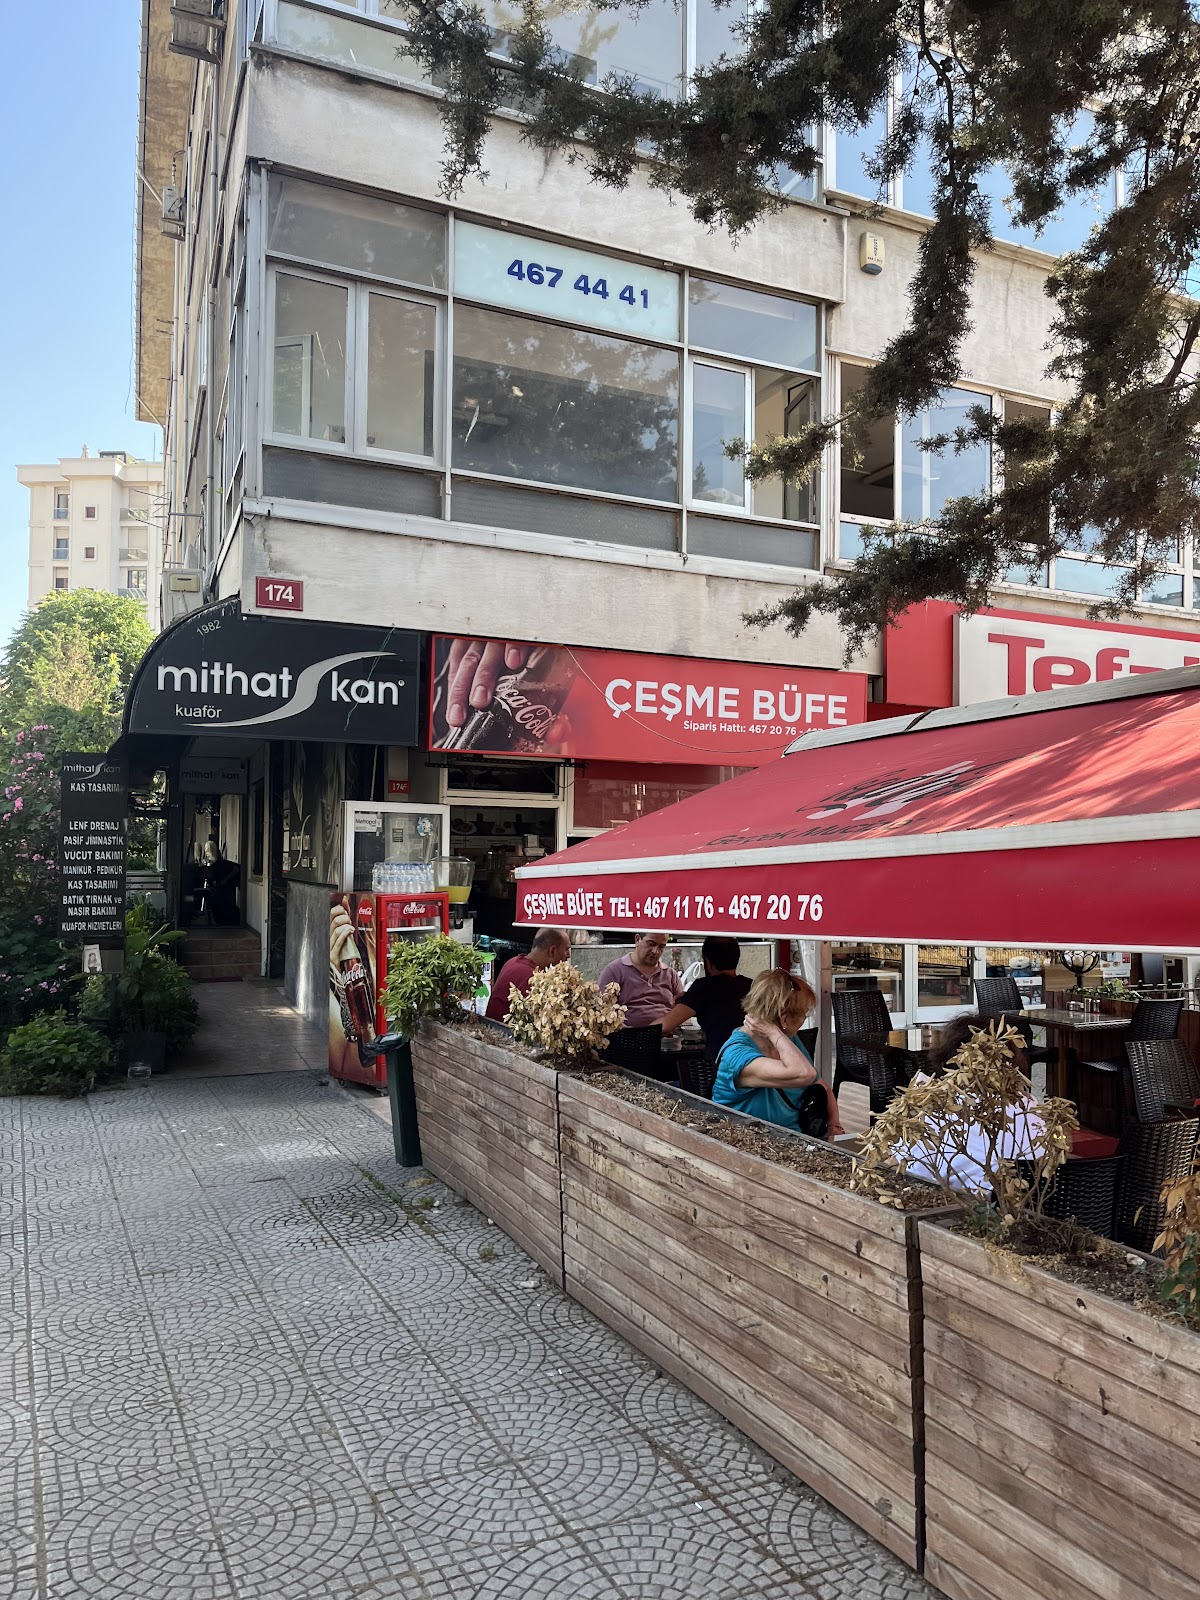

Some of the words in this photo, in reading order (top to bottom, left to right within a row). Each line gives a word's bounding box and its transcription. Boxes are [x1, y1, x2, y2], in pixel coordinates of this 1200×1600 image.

[507, 259, 564, 288] 467
[573, 274, 609, 299] 44
[619, 285, 649, 309] 41
[265, 584, 294, 603] 174
[196, 619, 221, 636] 1982
[987, 632, 1200, 696] Tef
[157, 661, 292, 698] mithat
[175, 703, 223, 718] kuaför
[605, 678, 740, 722] ÇEŞME
[753, 683, 848, 726] BÜFE
[683, 720, 717, 733] Sipariş
[719, 722, 746, 733] Hattı:
[748, 724, 767, 734] 467
[769, 725, 783, 735] 20
[785, 726, 797, 736] 76
[69, 821, 89, 831] LENF
[90, 821, 120, 831] DRENAJ
[63, 834, 84, 846] PASİF
[86, 894, 113, 904] TIRNAK
[523, 892, 565, 920] ÇEŞME
[566, 888, 604, 918] BÜFE
[643, 896, 670, 919] 467
[673, 895, 689, 919] 11
[694, 895, 714, 919] 76
[728, 894, 762, 920] 467
[766, 894, 791, 921] 20
[797, 894, 823, 922] 76
